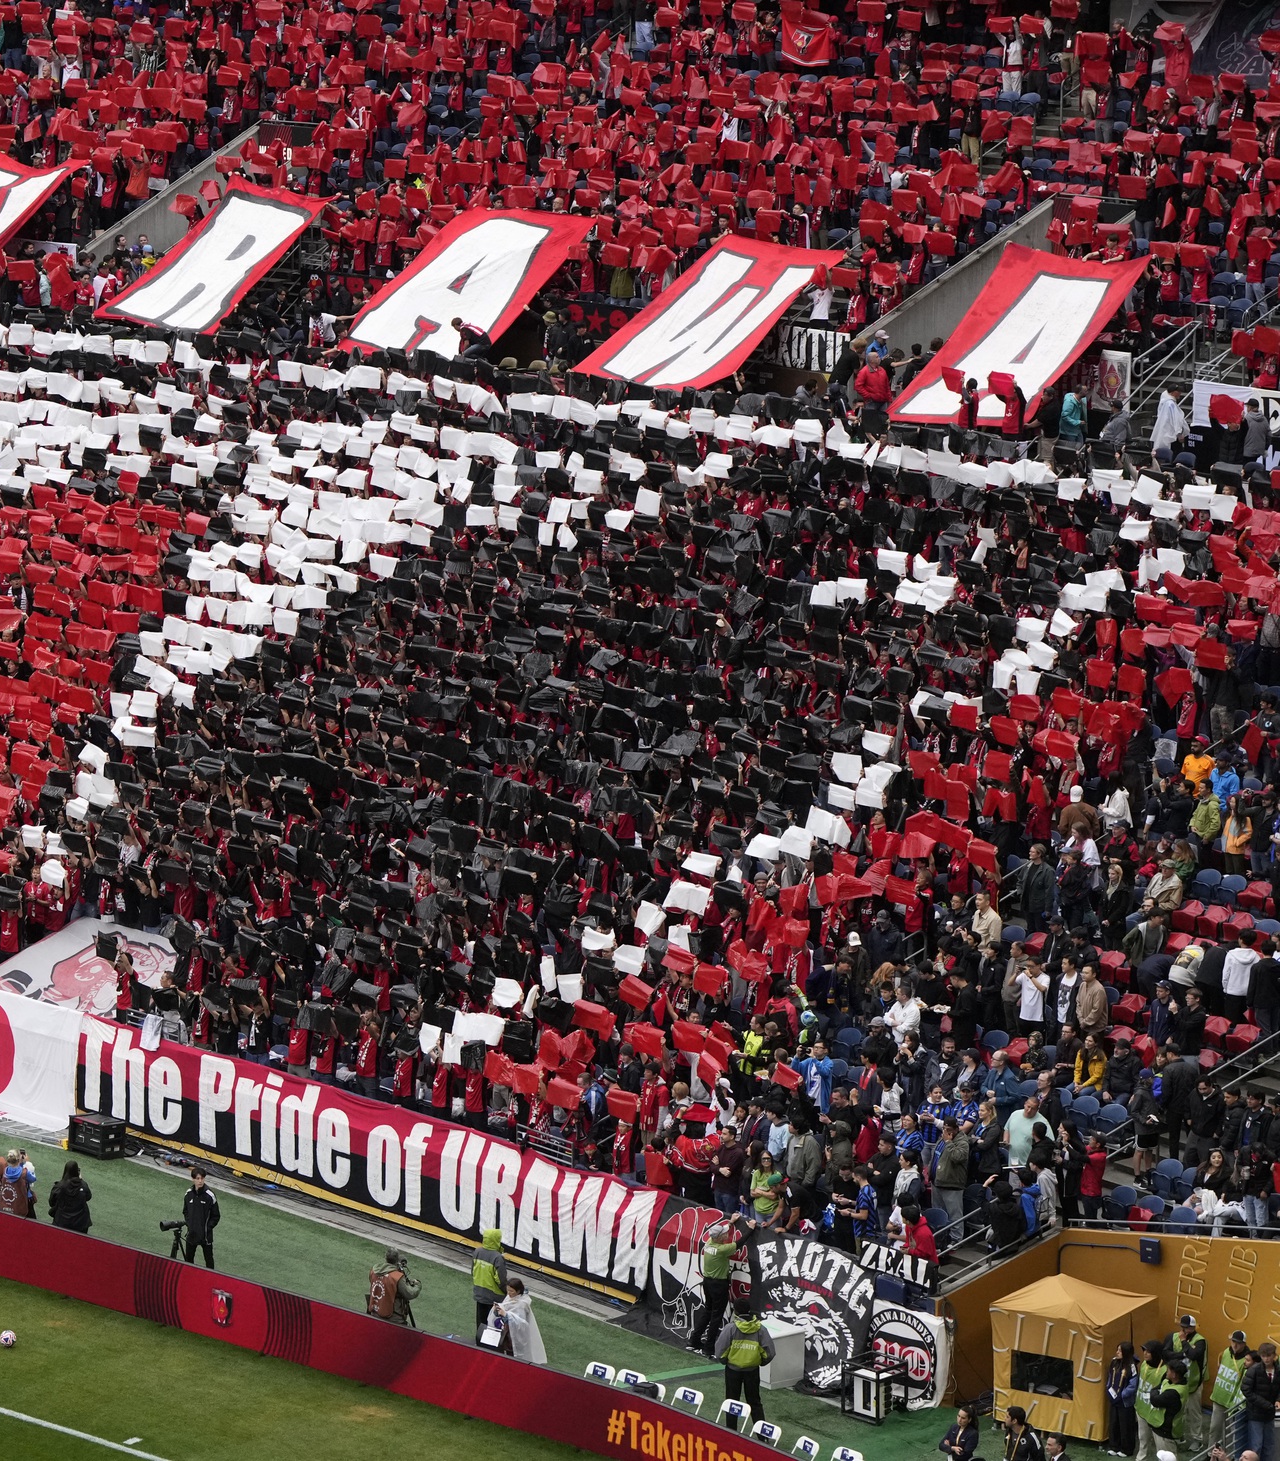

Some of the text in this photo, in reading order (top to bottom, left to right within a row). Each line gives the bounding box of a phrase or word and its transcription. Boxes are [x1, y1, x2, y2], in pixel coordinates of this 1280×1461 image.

[81, 1015, 183, 1135] The
[198, 1054, 352, 1189] Pride
[366, 1122, 434, 1217] of
[439, 1128, 658, 1291] URAWA
[757, 1239, 875, 1320] EXOTIC
[860, 1240, 931, 1288] ZEAL
[1222, 1245, 1258, 1323] CLUB
[732, 1339, 757, 1351] SECURITY
[870, 1310, 934, 1344] URAWA DANDYS
[1216, 1376, 1235, 1393] PITCH
[1218, 1364, 1238, 1382] FIFA
